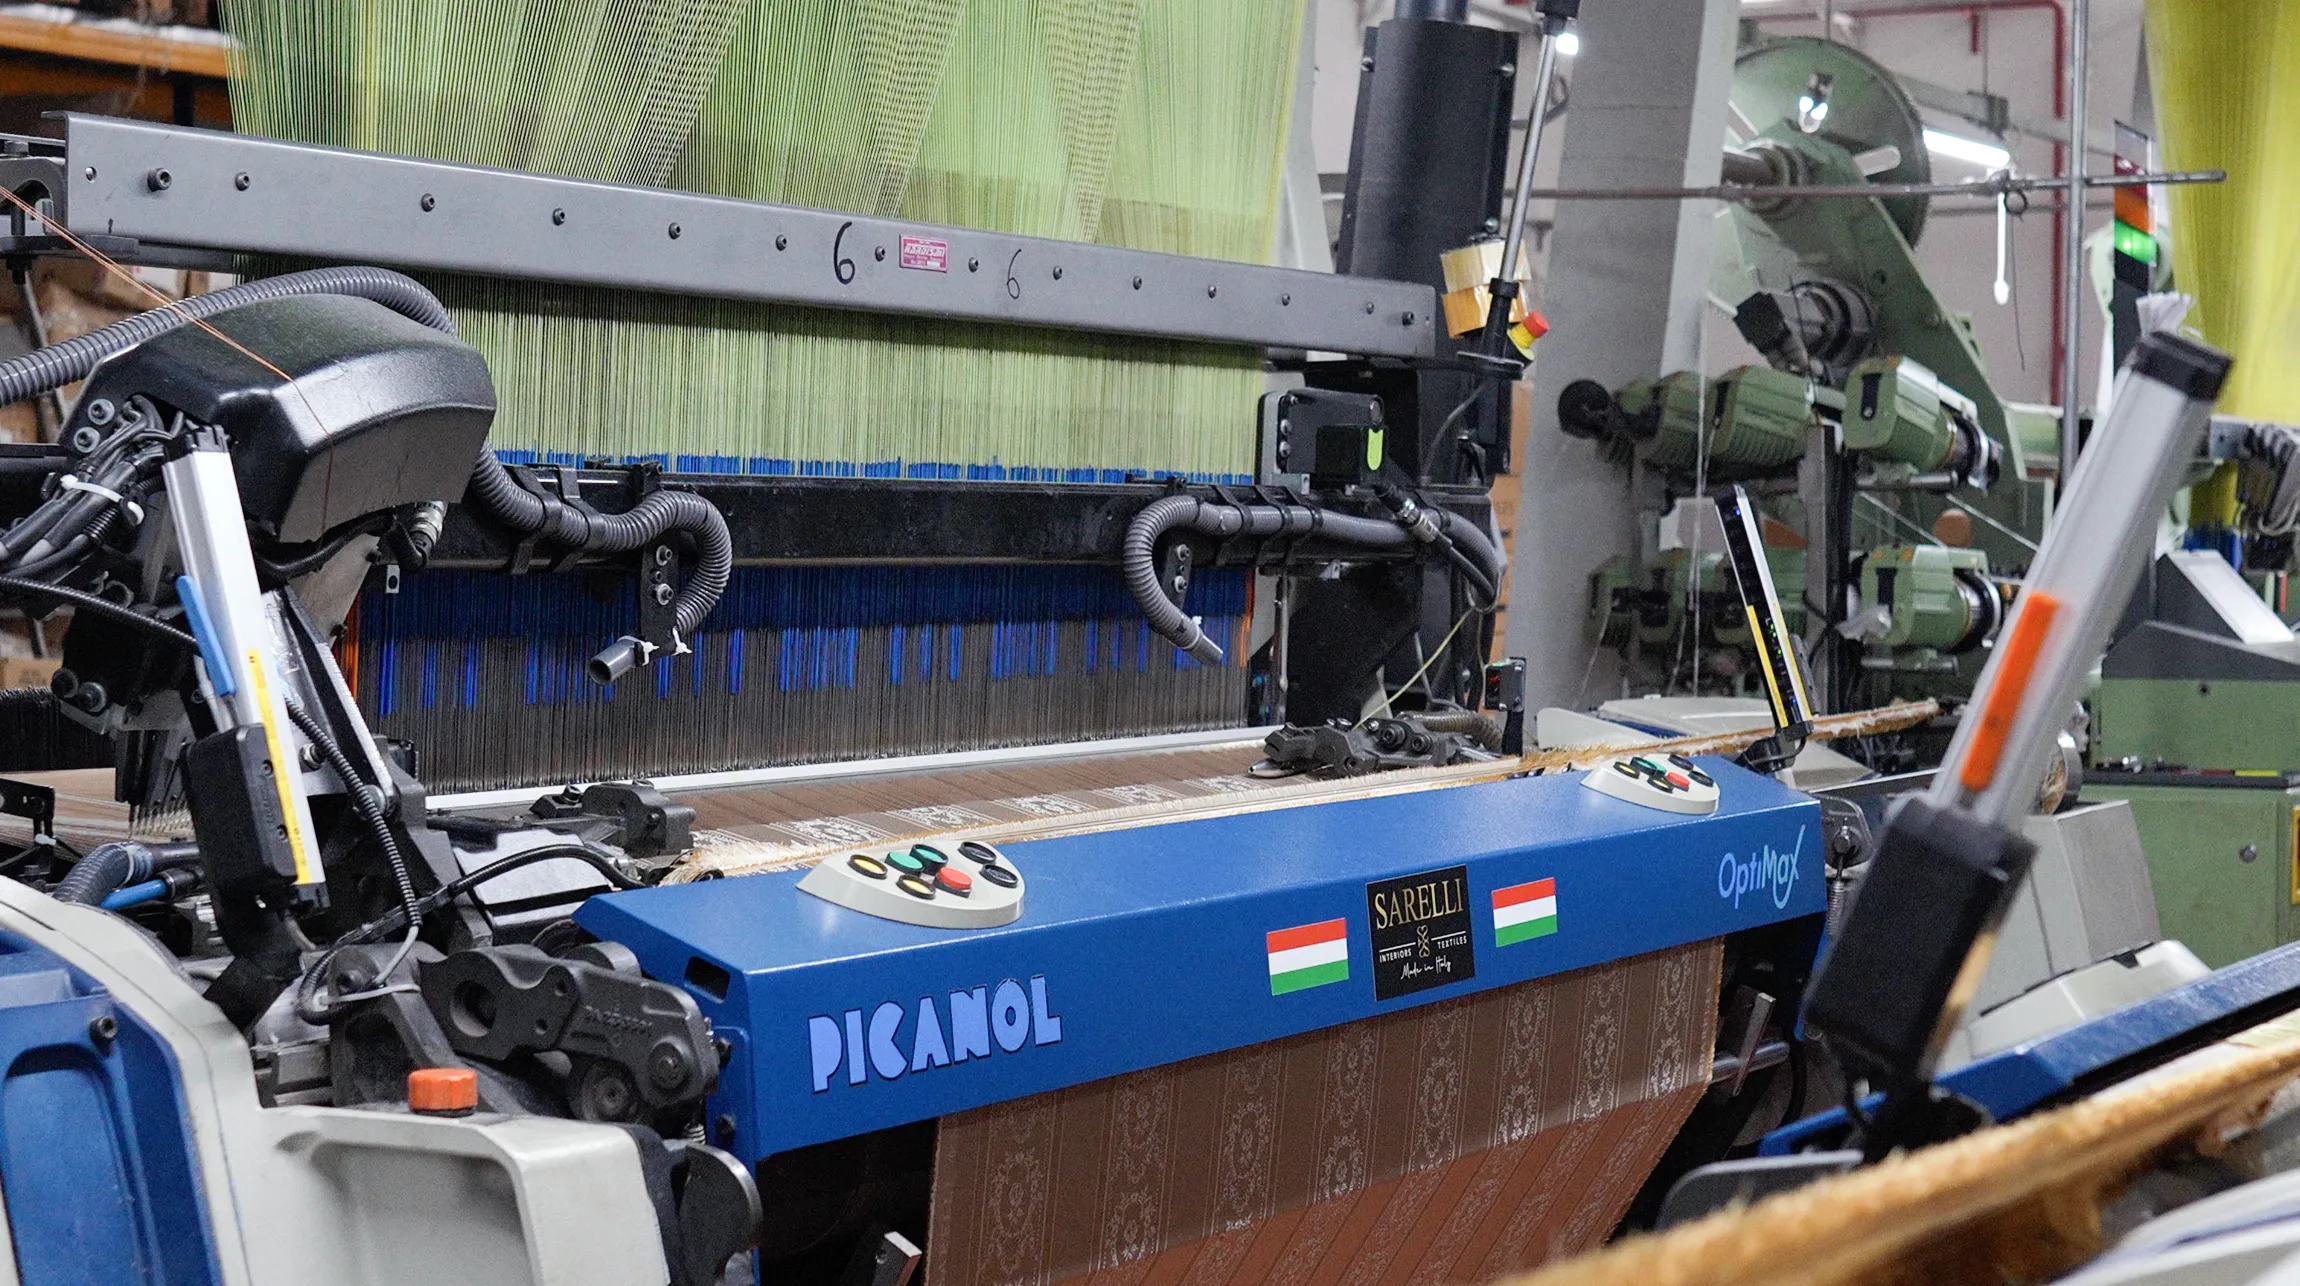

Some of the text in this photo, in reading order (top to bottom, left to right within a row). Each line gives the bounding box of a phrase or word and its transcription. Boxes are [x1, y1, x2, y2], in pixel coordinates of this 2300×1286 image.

[833, 221, 856, 285] 6
[1006, 248, 1022, 300] 6
[1718, 824, 1806, 910] OptiMax
[1375, 879, 1463, 929] SARELLI
[1379, 936, 1467, 962] INTERIORS TEXTILES
[1400, 956, 1451, 979] Made in Italy
[808, 974, 1062, 1094] PICANOL
